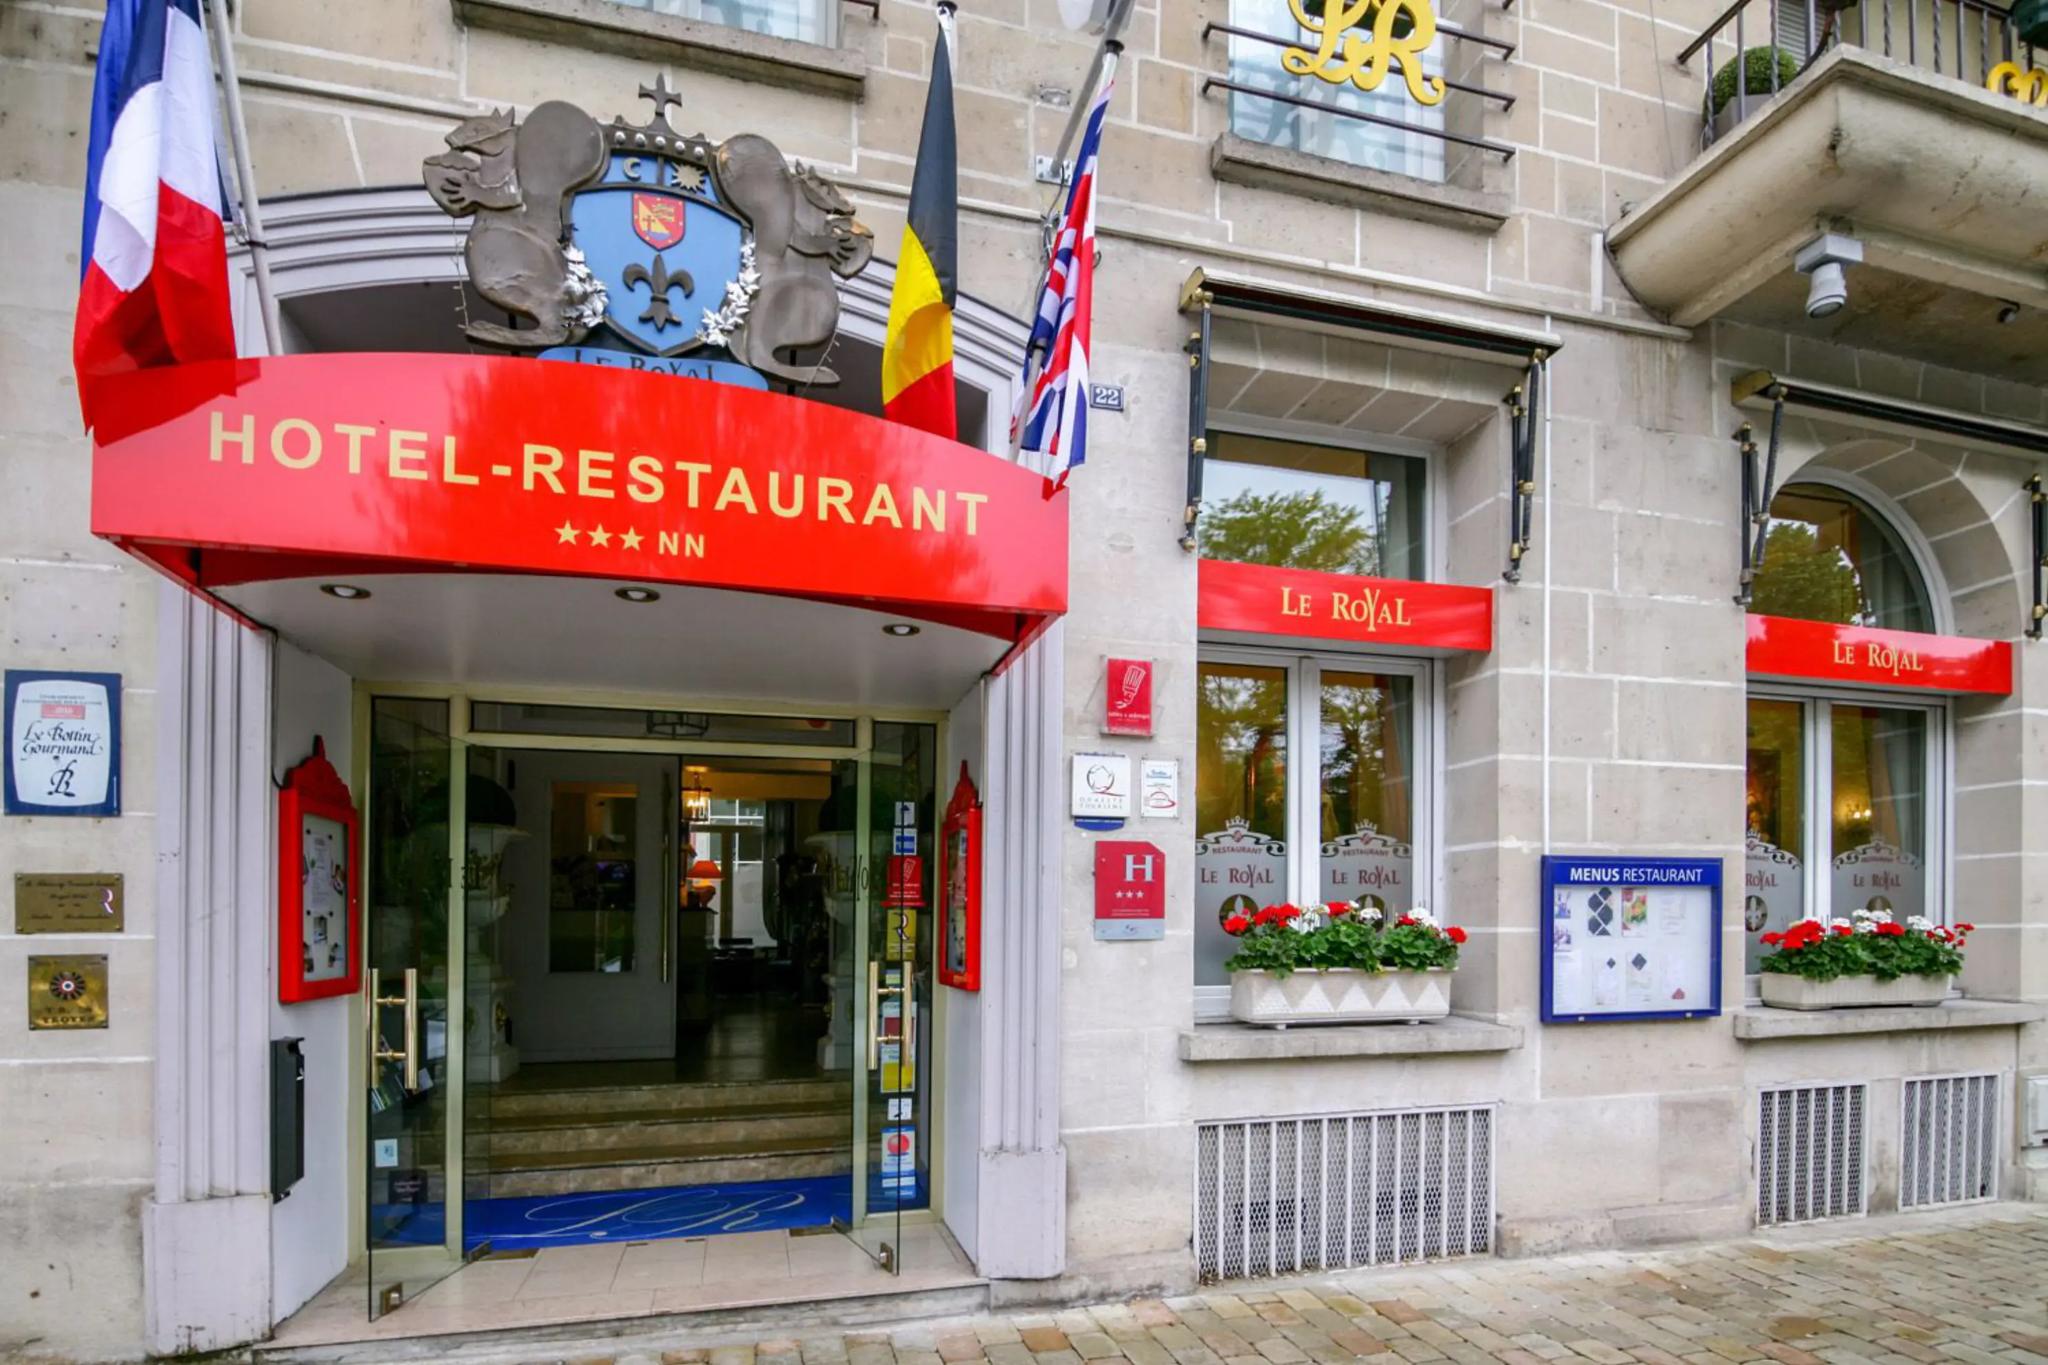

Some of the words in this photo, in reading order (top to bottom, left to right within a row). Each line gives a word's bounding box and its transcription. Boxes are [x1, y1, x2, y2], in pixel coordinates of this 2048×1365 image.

[1095, 387, 1119, 405] 22
[209, 411, 989, 536] HOTEL-RESTAURANT
[658, 530, 705, 558] NN
[20, 736, 103, 760] Gourmand
[1124, 854, 1154, 882] H
[1570, 867, 1620, 881] MENUS
[1623, 869, 1703, 882] RESTAURANT
